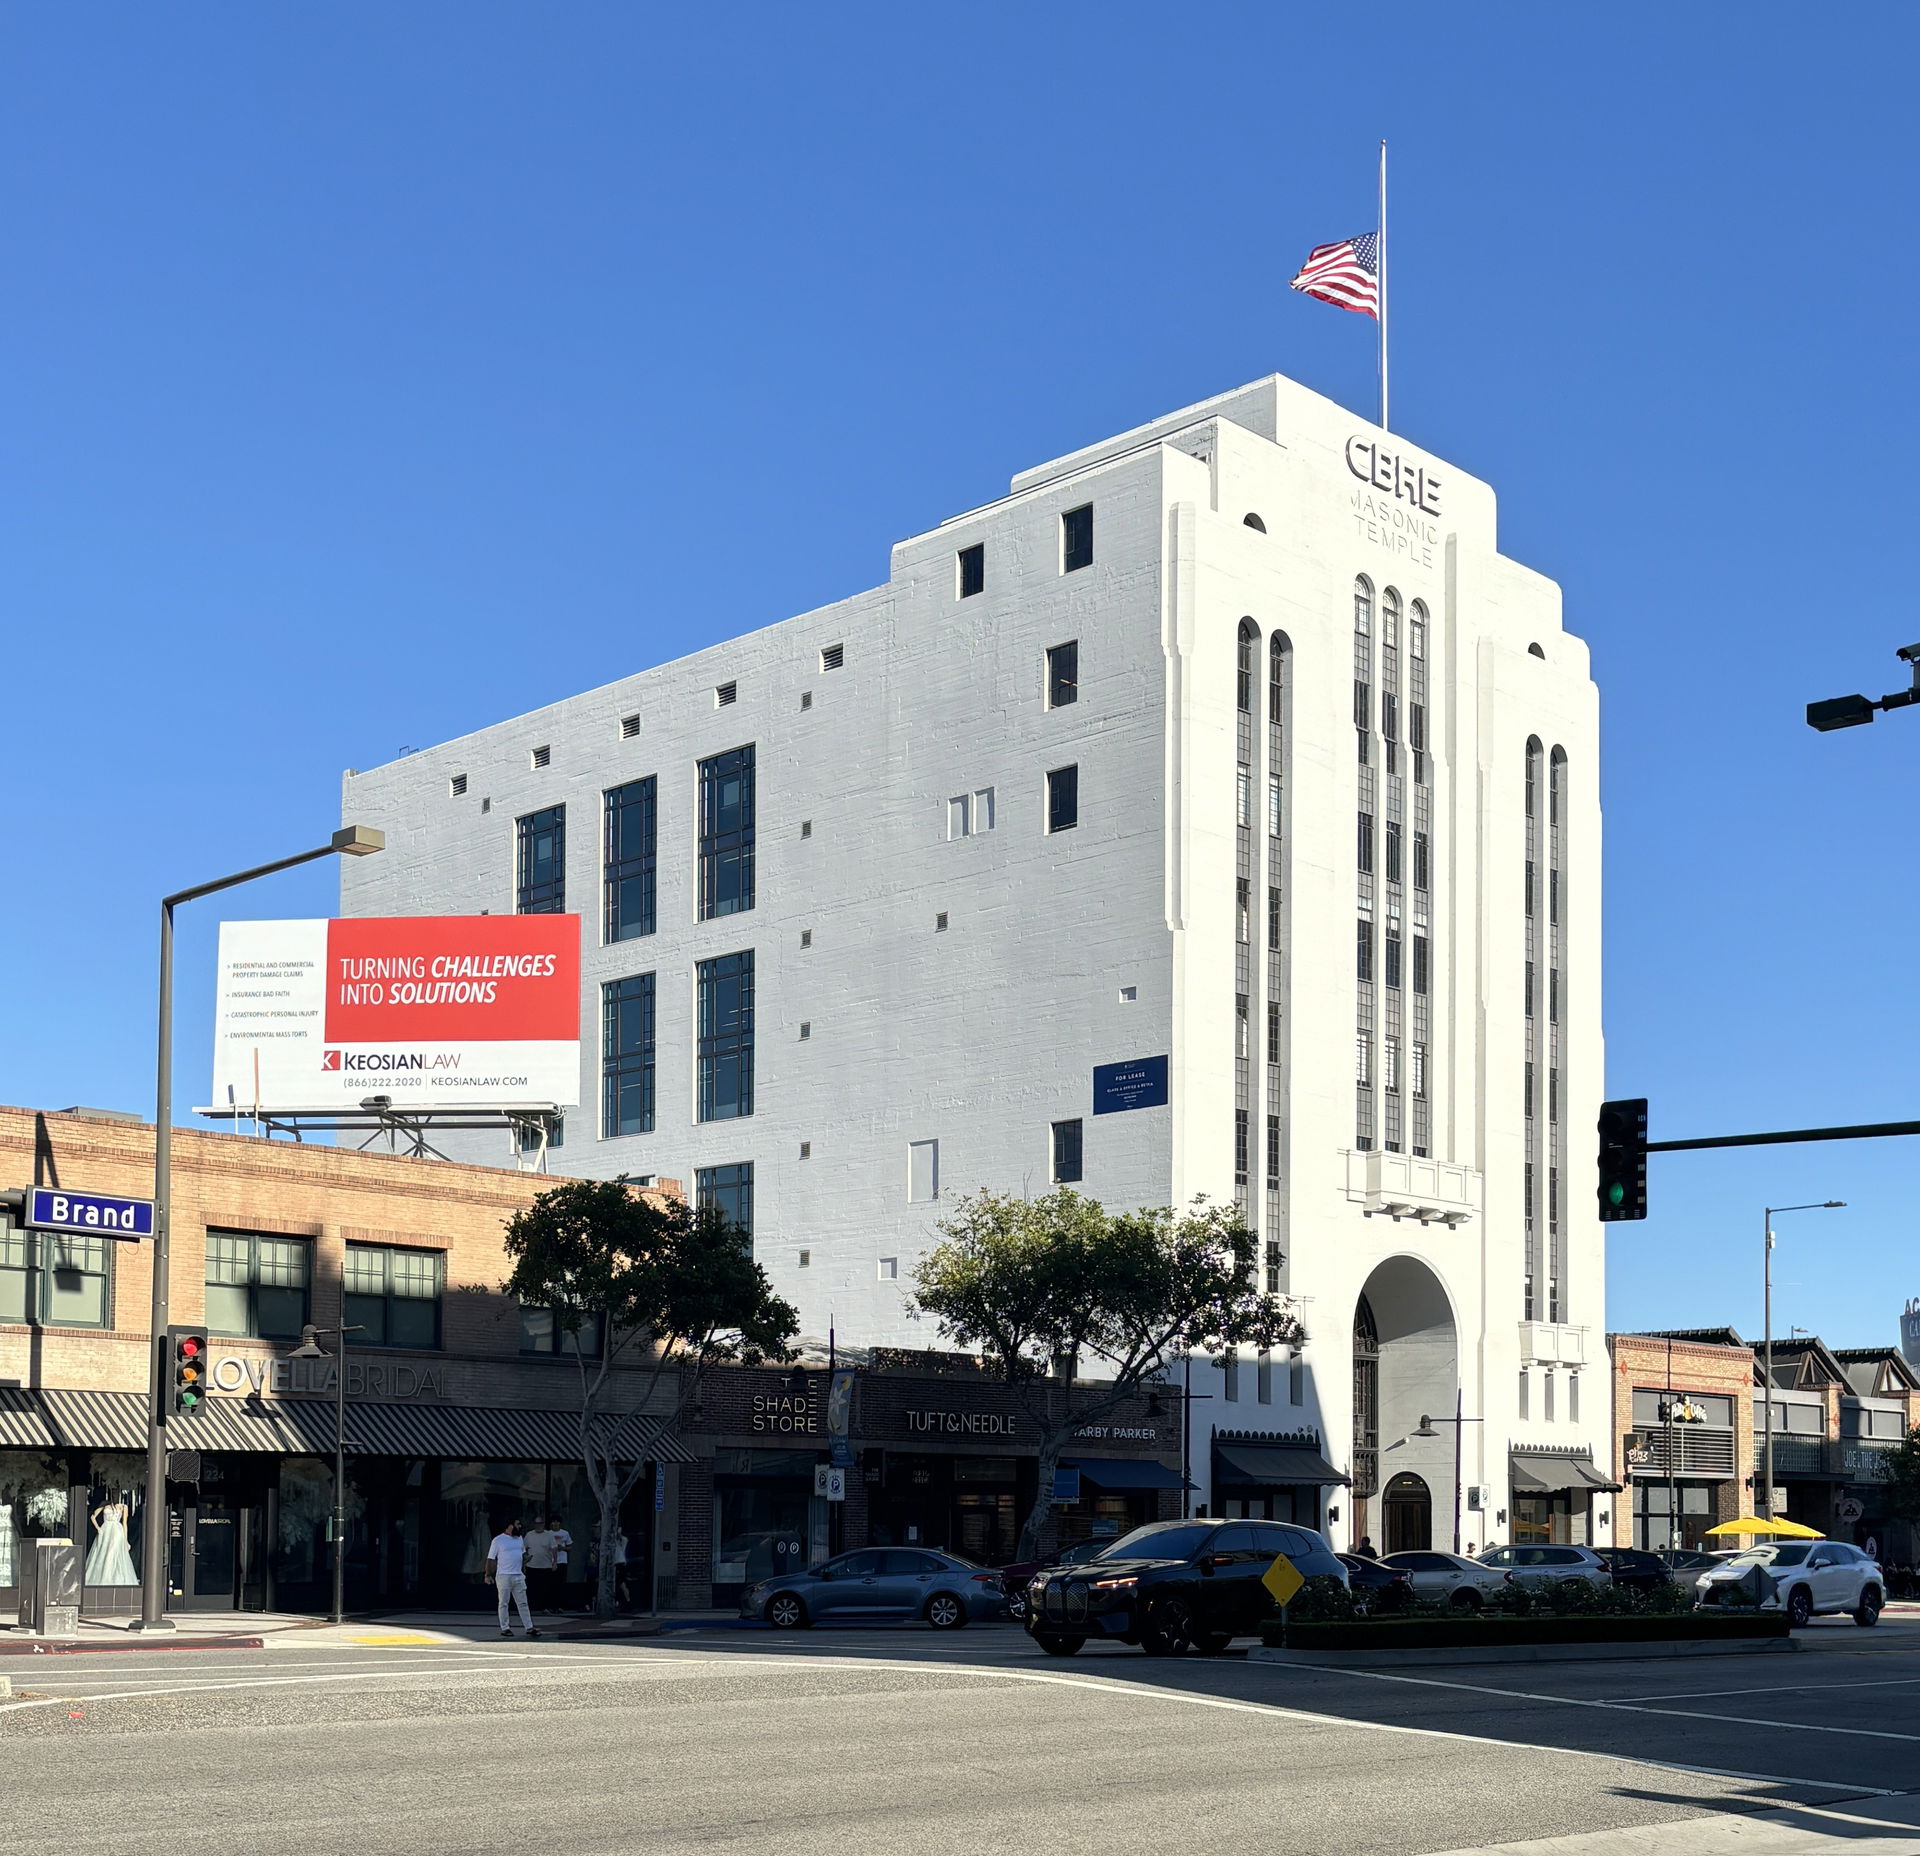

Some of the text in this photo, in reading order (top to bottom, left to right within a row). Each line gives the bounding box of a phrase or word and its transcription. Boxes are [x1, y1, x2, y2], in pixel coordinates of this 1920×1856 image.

[1345, 434, 1442, 517] CBRE
[1350, 489, 1437, 545] MASONIC
[1354, 514, 1432, 569] TEMPLE
[340, 954, 556, 980] TURNING CHALLENGES
[340, 981, 497, 1005] INTO SOLUTIONS
[270, 1010, 298, 1018] PERSONAL
[344, 1052, 461, 1070] KEOSIANLAW
[343, 1076, 528, 1089] (866)222.2020 KEOSIANLAW.COM
[1128, 1071, 1145, 1080] LEASE
[52, 1196, 135, 1229] Brand
[781, 1377, 818, 1394] TE
[753, 1395, 818, 1413] SHADE
[753, 1414, 818, 1433] STORE
[1074, 1426, 1156, 1440] ARBY PARKER
[1844, 1450, 1856, 1468] JOE
[1861, 1451, 1873, 1469] THE
